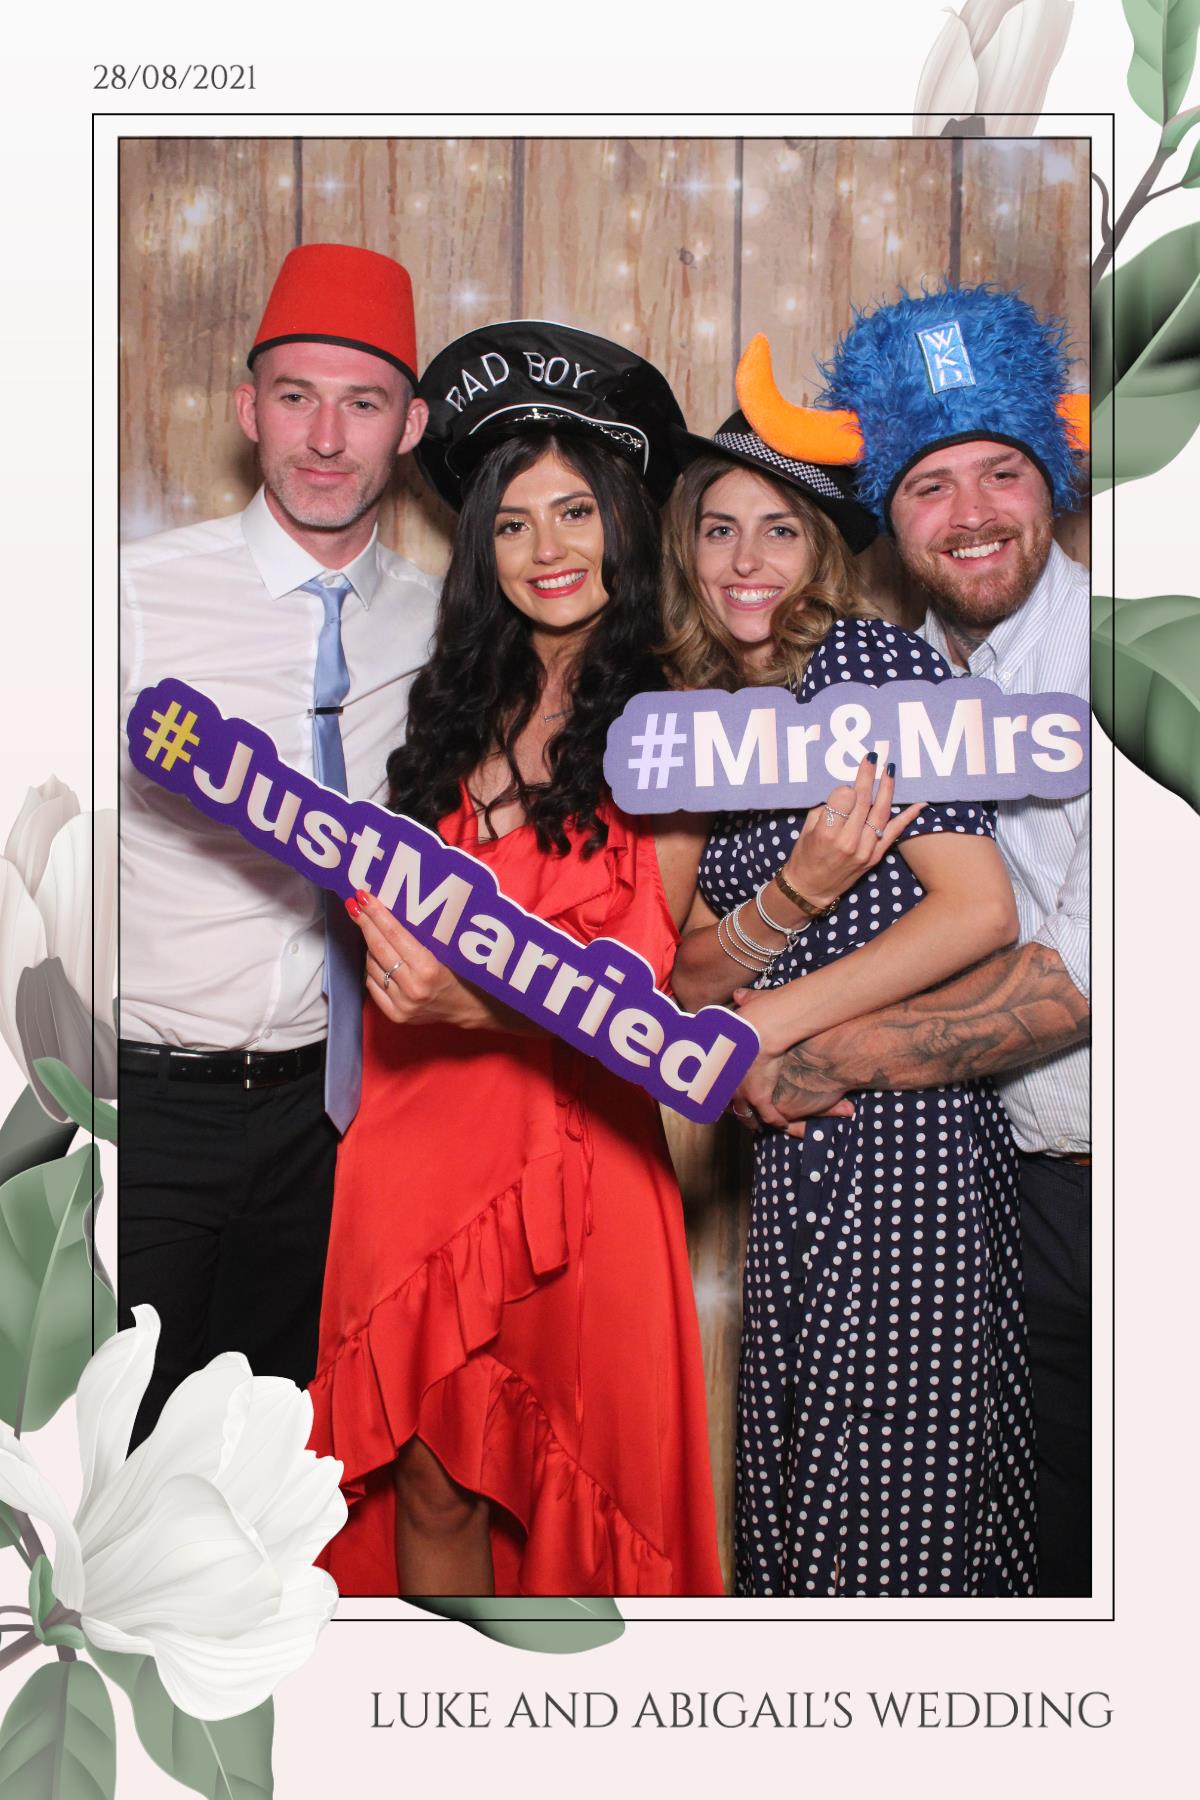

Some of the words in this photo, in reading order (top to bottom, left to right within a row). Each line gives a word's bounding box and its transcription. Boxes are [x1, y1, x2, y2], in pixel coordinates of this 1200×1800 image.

[522, 351, 596, 389] BOY
[924, 327, 962, 387] WKD
[628, 698, 1084, 790] #Mr&Mrs
[143, 700, 737, 1105] #JustMarried
